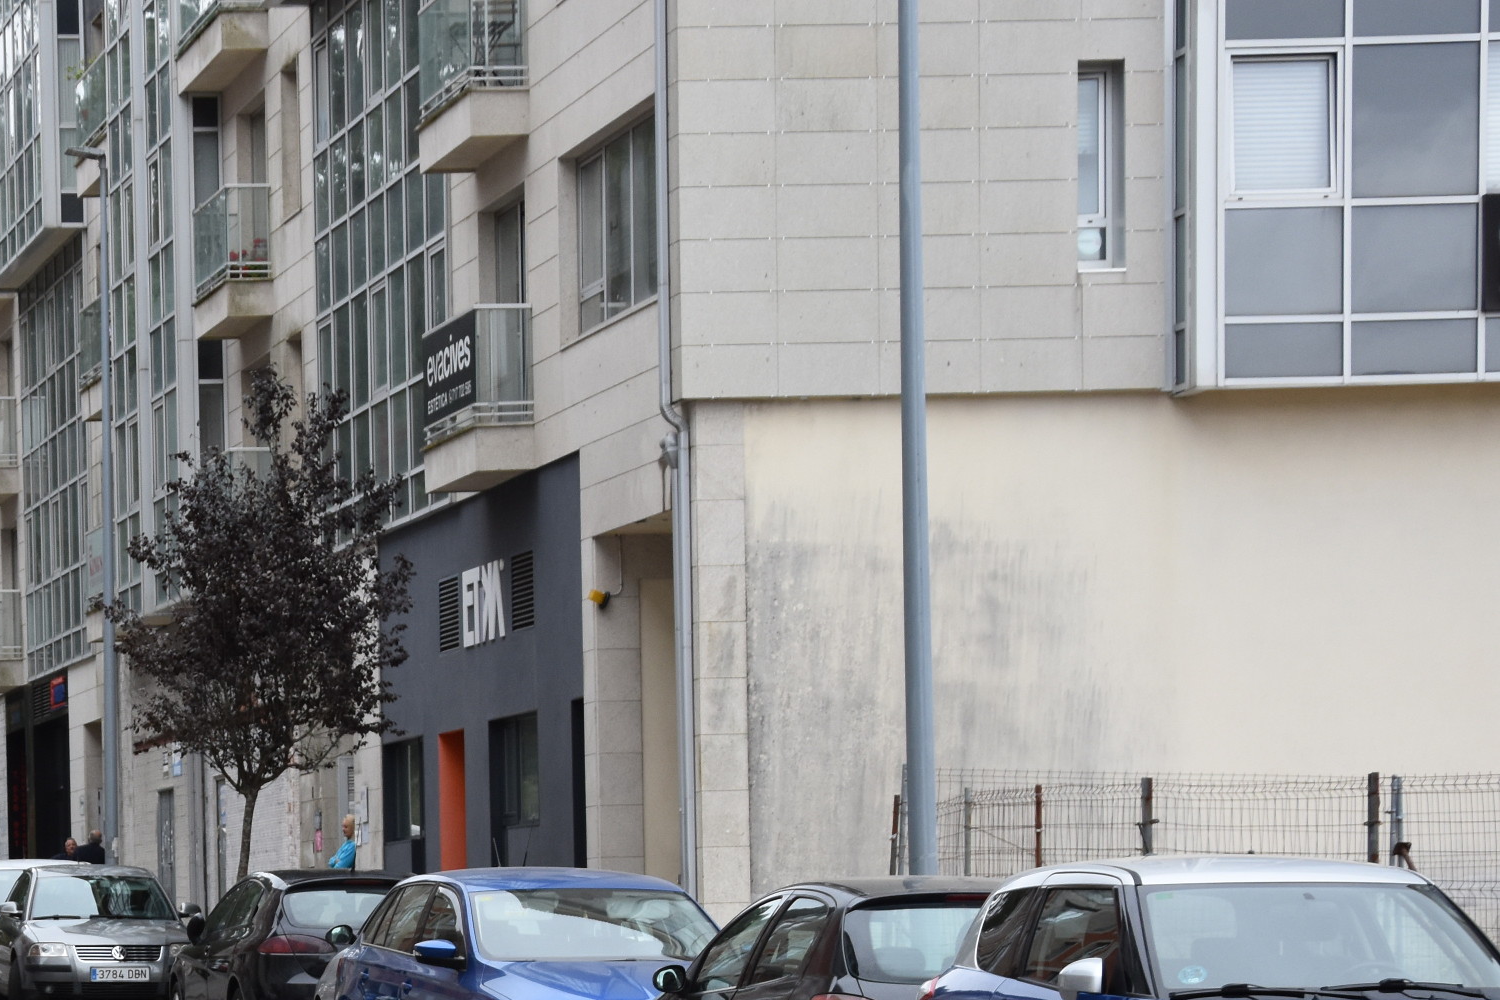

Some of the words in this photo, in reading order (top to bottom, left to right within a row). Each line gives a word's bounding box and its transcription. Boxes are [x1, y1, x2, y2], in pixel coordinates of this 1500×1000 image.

[427, 334, 471, 387] evacives
[428, 393, 448, 415] ESTÉTICA
[99, 970, 124, 979] 3784
